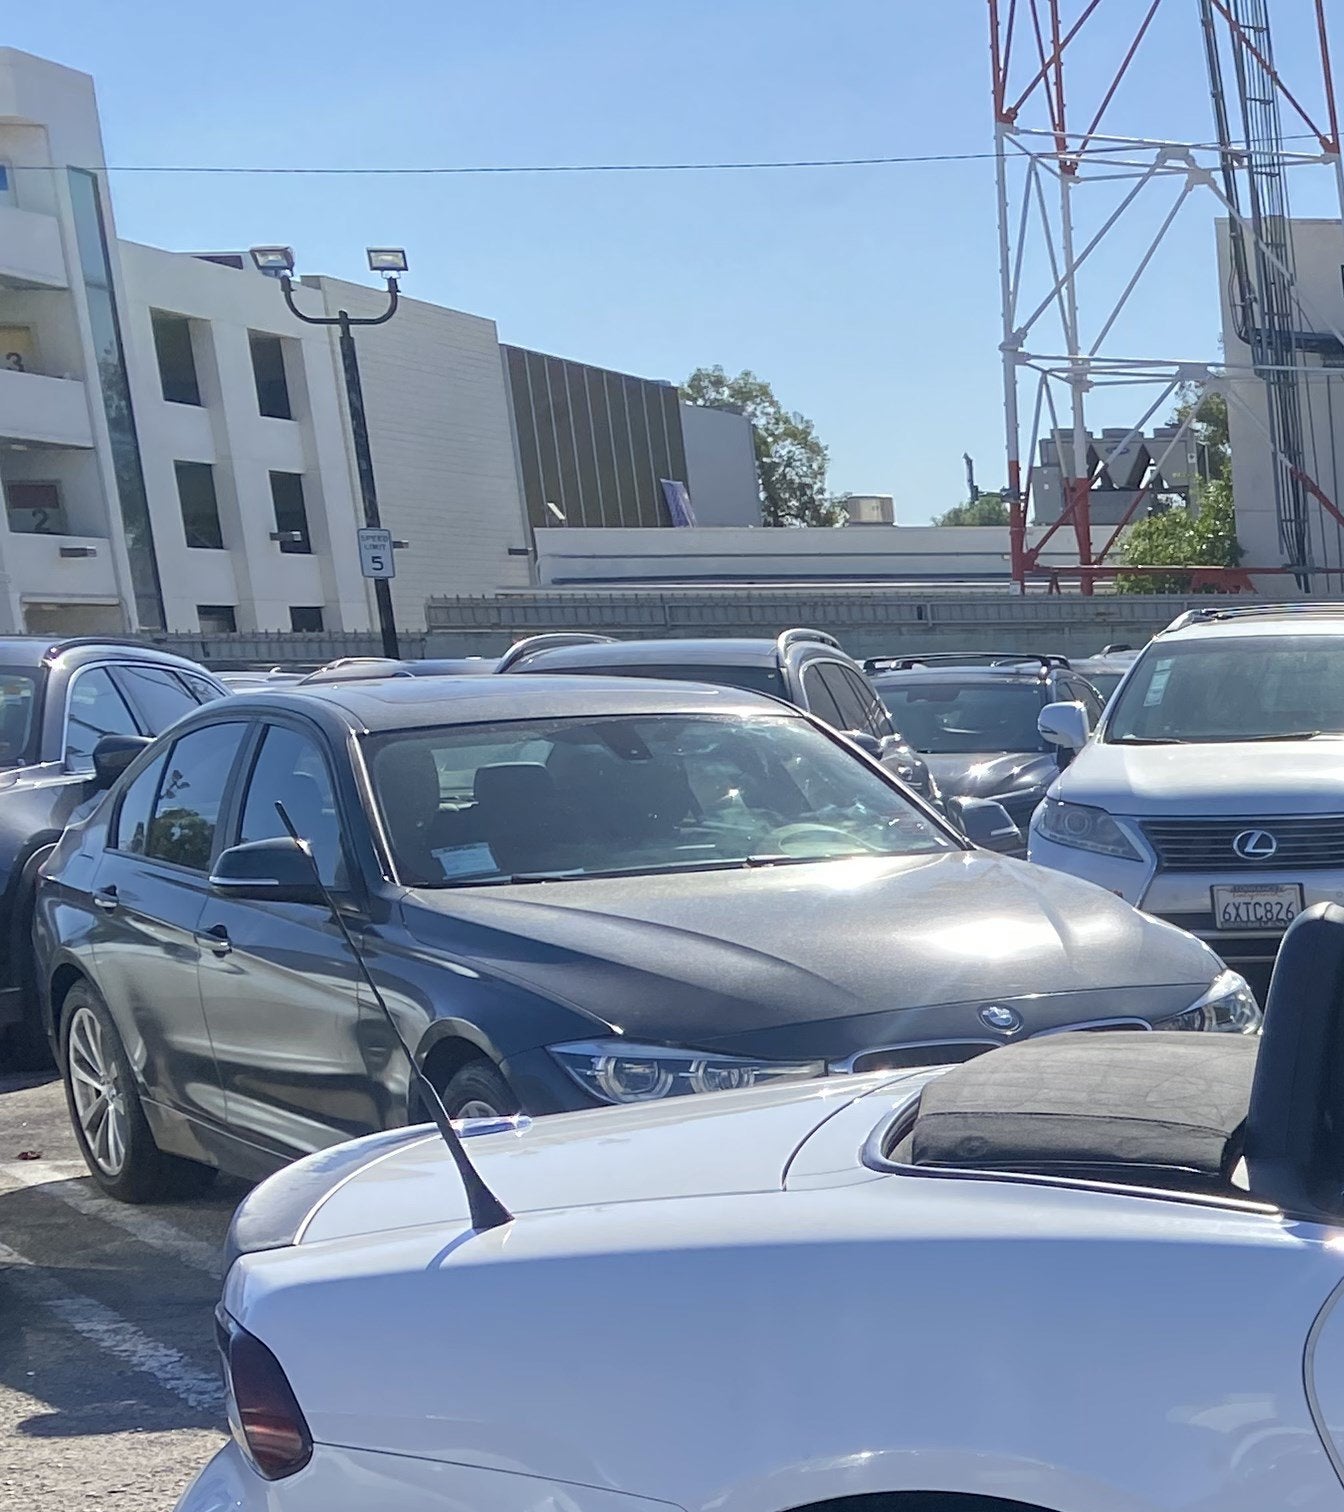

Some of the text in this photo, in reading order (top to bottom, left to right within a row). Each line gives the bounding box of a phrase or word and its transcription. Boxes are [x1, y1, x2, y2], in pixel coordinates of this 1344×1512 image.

[6, 352, 24, 372] 3
[31, 508, 50, 532] 2
[371, 555, 384, 571] 5
[1222, 901, 1295, 922] 6XTC826
